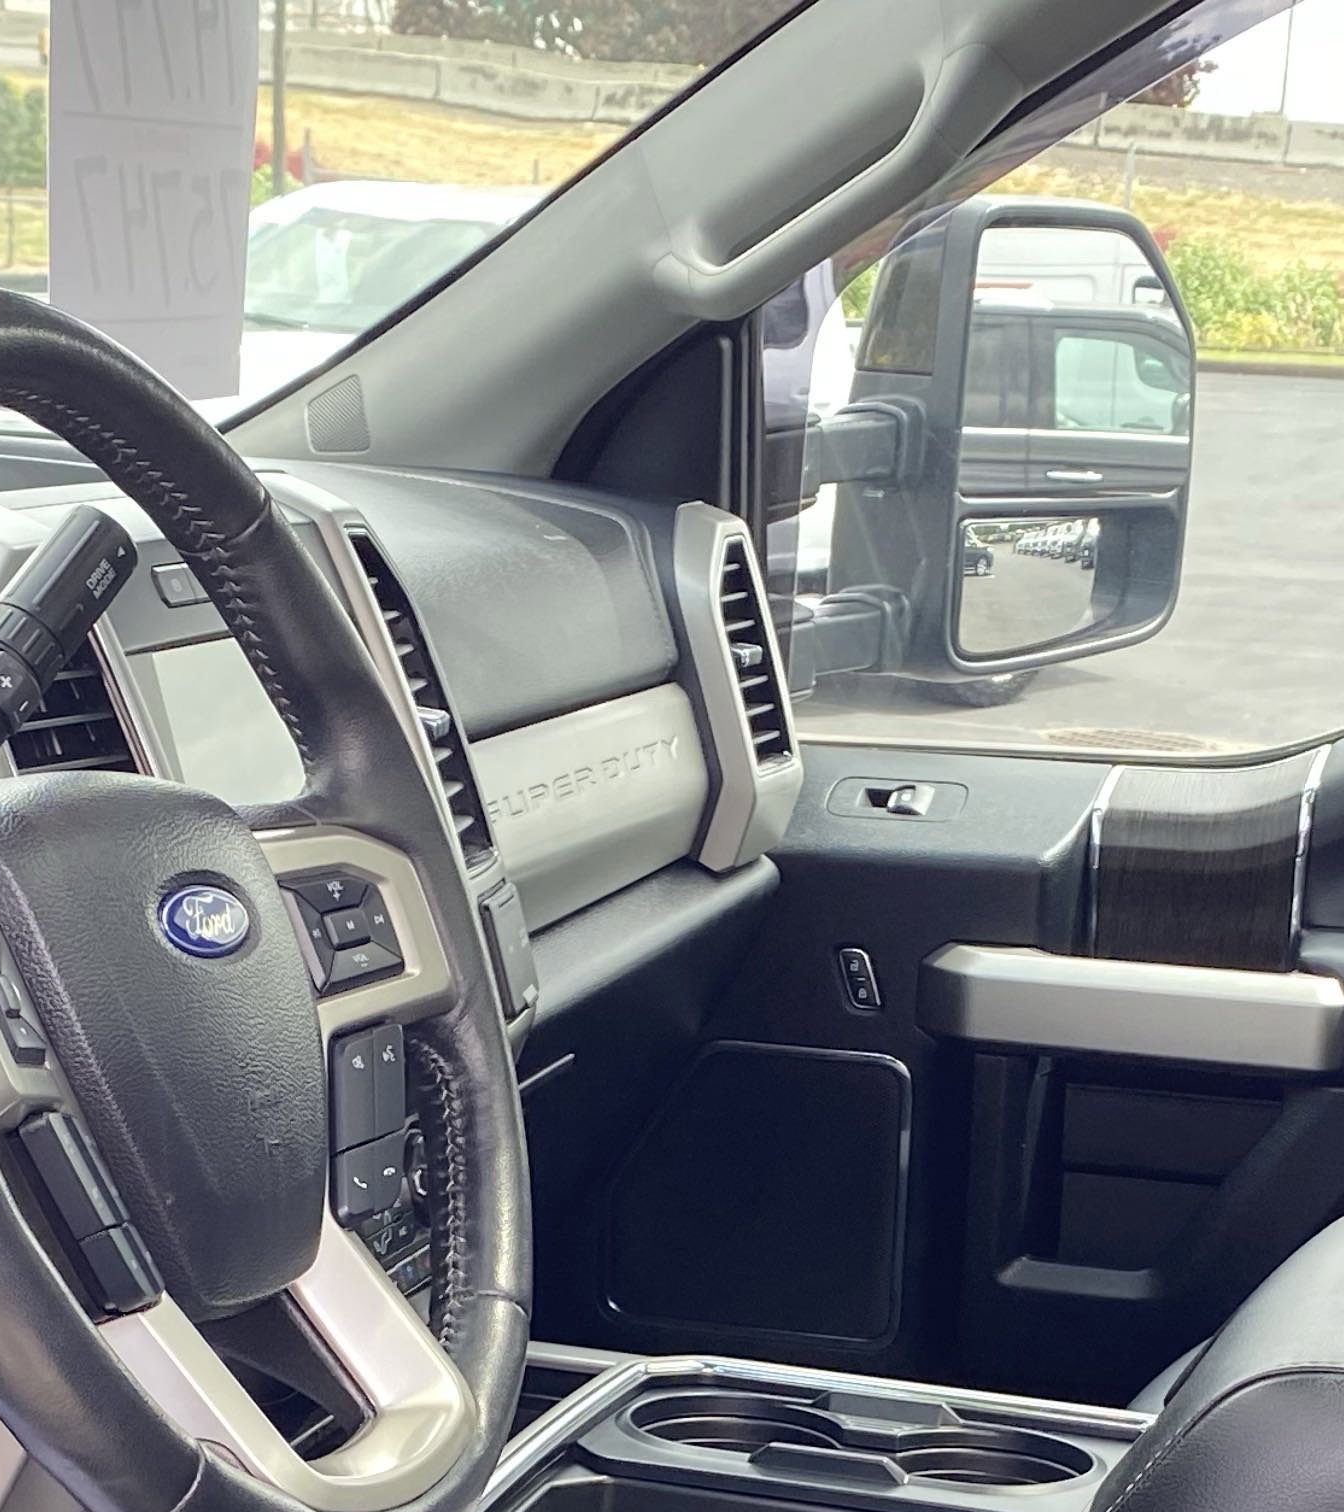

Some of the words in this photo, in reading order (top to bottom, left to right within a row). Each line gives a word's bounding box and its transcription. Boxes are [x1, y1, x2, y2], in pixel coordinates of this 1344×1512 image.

[85, 558, 111, 590] DRIVE
[92, 567, 117, 600] MODE
[601, 735, 680, 779] DUTY
[326, 880, 345, 893] VOL
[182, 891, 237, 941] Ford
